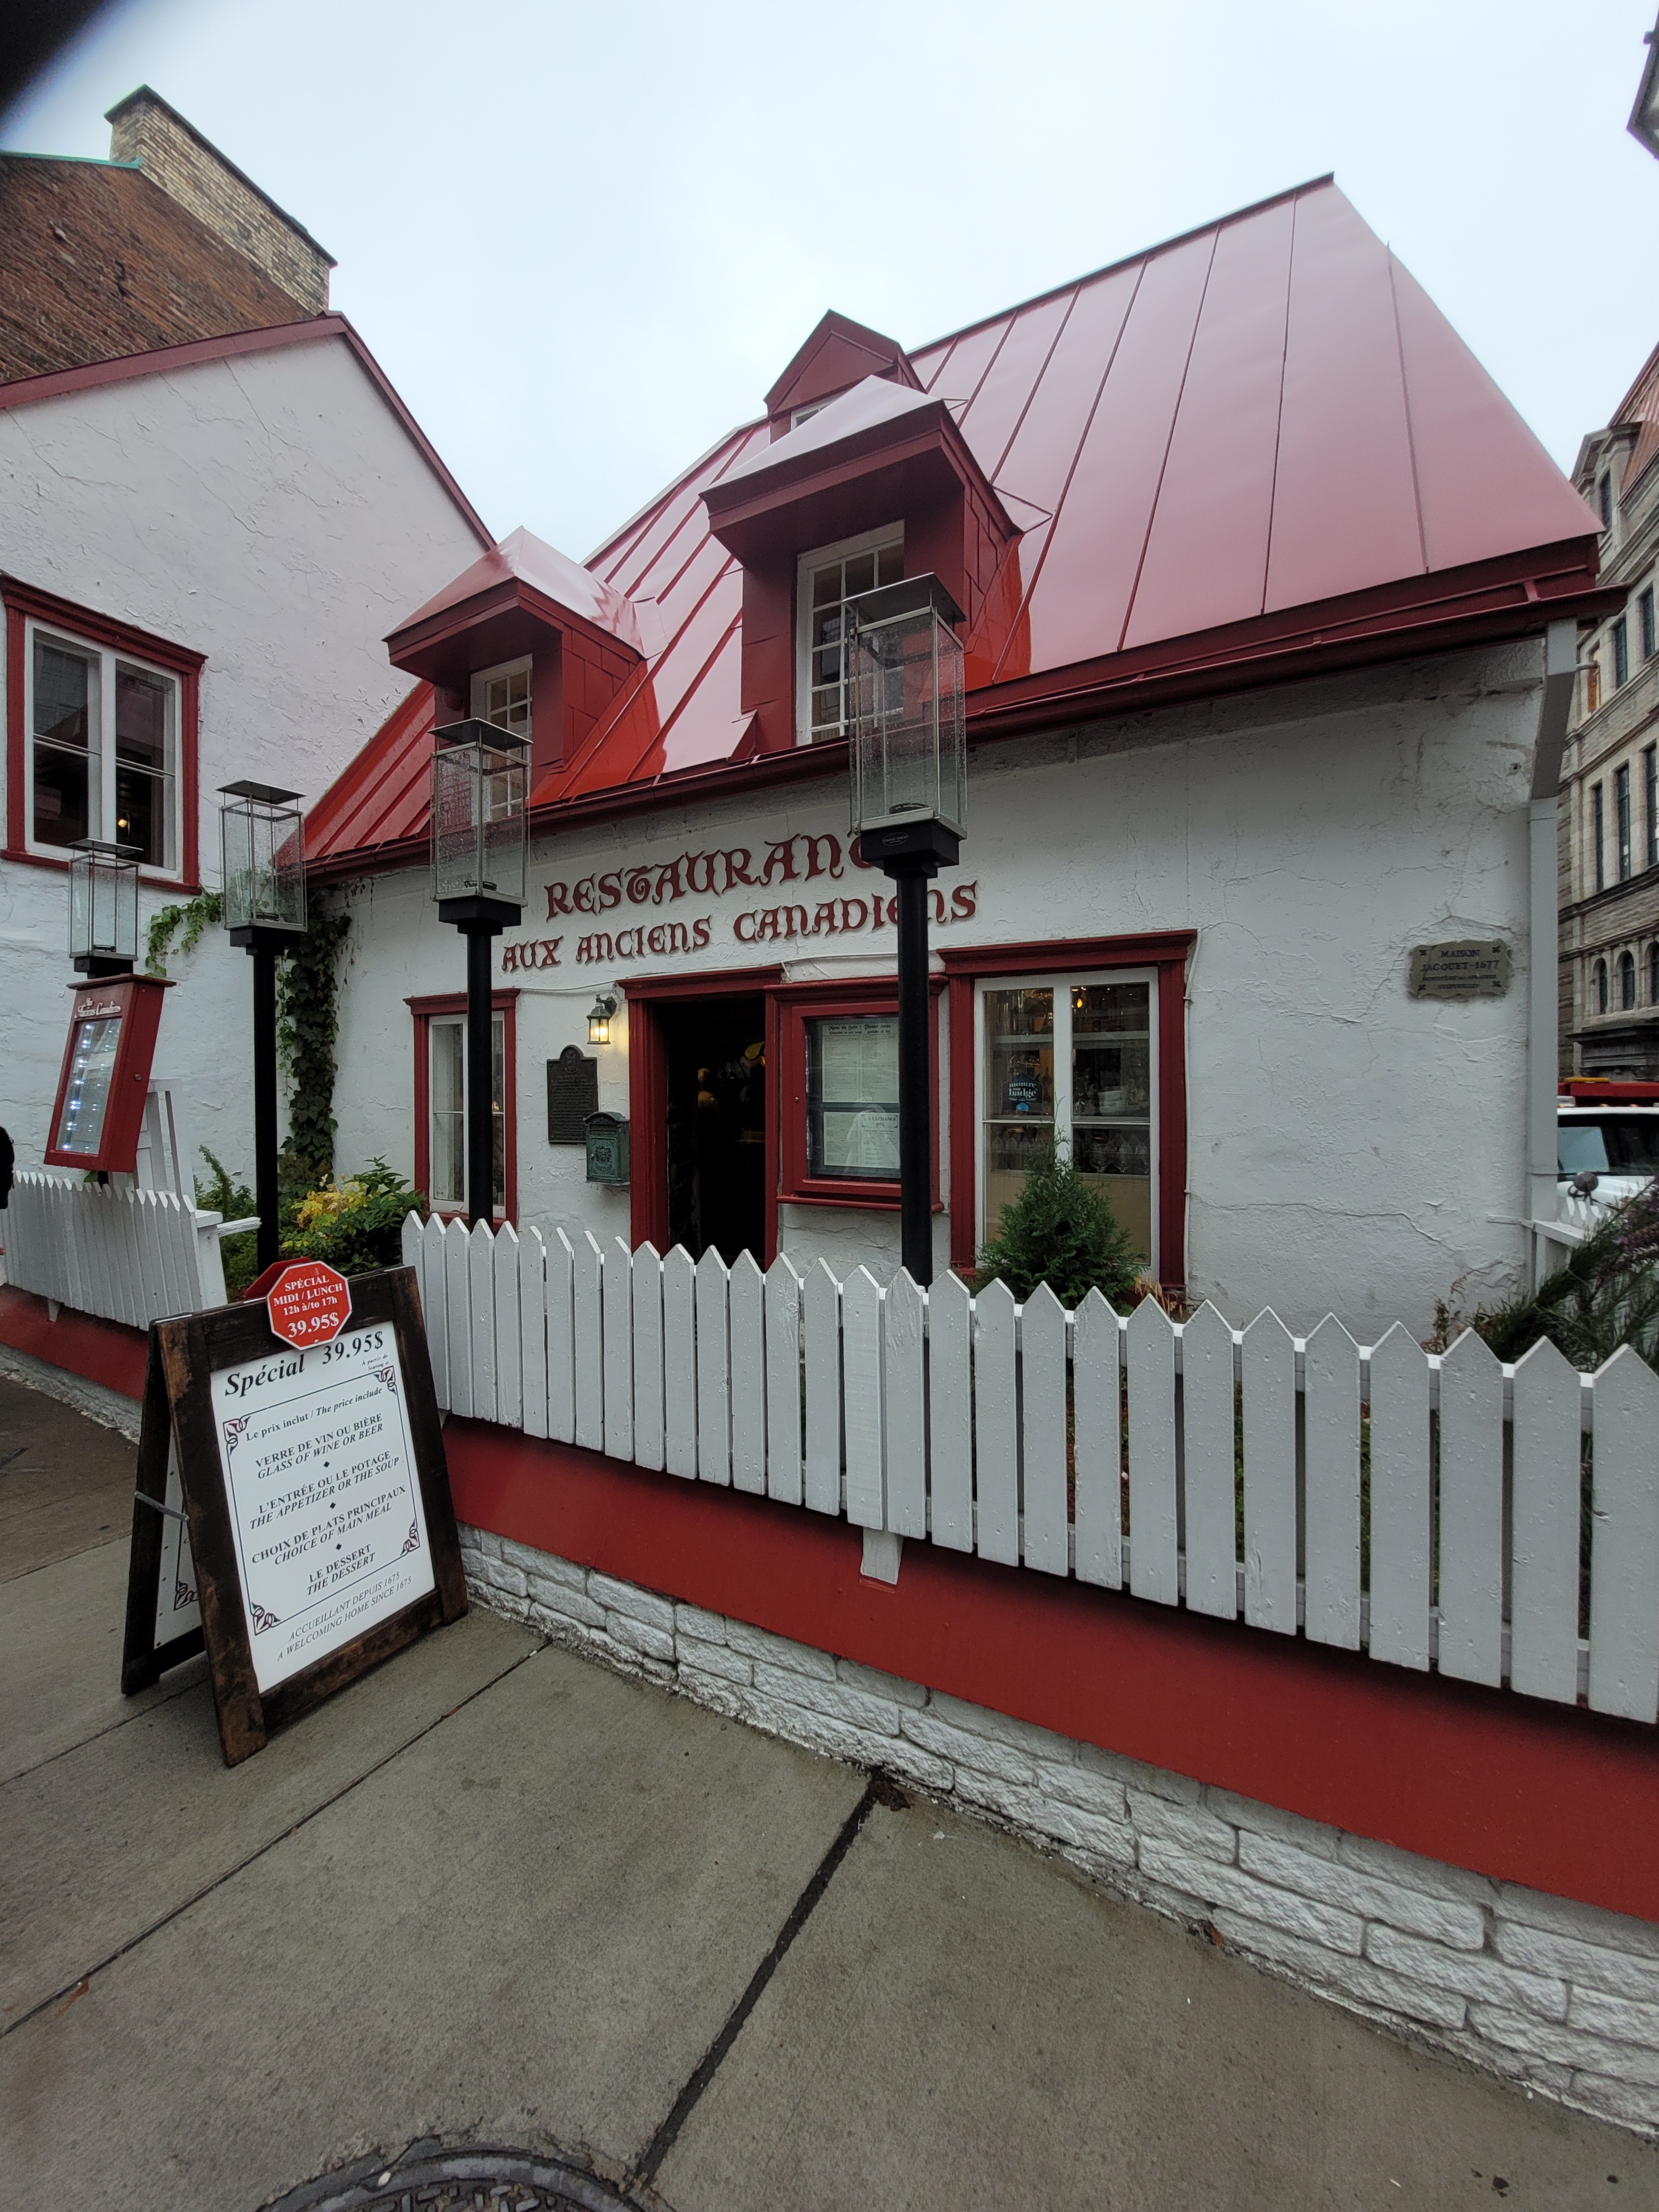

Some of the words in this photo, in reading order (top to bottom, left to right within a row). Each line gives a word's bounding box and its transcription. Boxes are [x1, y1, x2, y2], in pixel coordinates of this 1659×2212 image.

[502, 936, 564, 973] AUX
[576, 914, 712, 966] ANCIENS
[1441, 950, 1480, 958] MAISON
[1009, 1088, 1036, 1098] badge
[273, 1293, 300, 1306] MIDI
[301, 1291, 305, 1300] /
[306, 1283, 343, 1301] LUNCH
[284, 1305, 300, 1316] 12h
[322, 1296, 338, 1306] 17h
[285, 1275, 330, 1291] SPÉCIAL
[288, 1312, 339, 1338] 39.95$
[225, 1354, 305, 1397] Spécial
[322, 1331, 383, 1364] 39.95$
[367, 1356, 382, 1365] partir
[368, 1363, 384, 1371] Starting
[246, 1432, 259, 1441] Le
[262, 1423, 281, 1438] prix
[283, 1413, 309, 1428] inclut
[311, 1410, 314, 1418] /
[316, 1406, 332, 1417] The
[333, 1397, 353, 1413] price
[355, 1387, 383, 1402] include
[255, 1447, 295, 1468] VERRE
[298, 1440, 314, 1453] DE
[315, 1431, 334, 1445] VIN
[336, 1425, 352, 1438] OU
[353, 1413, 383, 1431] BIÈRE
[258, 1458, 293, 1479] GLASS
[295, 1452, 310, 1464] OF
[313, 1440, 341, 1458] WINE
[342, 1433, 356, 1446] OR
[358, 1423, 383, 1440] BEER
[249, 1512, 273, 1530] THE
[275, 1485, 335, 1519] APPETIZER
[338, 1478, 352, 1491] OR
[354, 1468, 373, 1484] THE
[375, 1457, 400, 1475] SOUP
[259, 1483, 316, 1514] L'ENTRÉE
[317, 1475, 333, 1488] OU
[336, 1469, 349, 1481] LE
[351, 1451, 391, 1474] POTAGE
[252, 1538, 291, 1563] CHOIX
[294, 1531, 310, 1545] DE
[311, 1514, 345, 1536] PLATS
[347, 1484, 406, 1519] PRINCIPAUX
[274, 1537, 317, 1565] CHOICE
[320, 1530, 334, 1543] OF
[337, 1517, 363, 1536] MAIN
[365, 1502, 392, 1521] MEAL
[307, 1577, 329, 1596] THE
[331, 1552, 376, 1583] DESSERT
[309, 1569, 324, 1583] LE
[326, 1543, 372, 1575] DESSERT
[277, 1651, 284, 1661] A
[286, 1616, 342, 1655] WELCOMING
[344, 1601, 370, 1623] HOME
[371, 1586, 395, 1606] SINCE
[396, 1576, 412, 1592] 1675
[289, 1599, 351, 1642] ACCUEILLANT
[352, 1582, 383, 1605] DEPUIS
[384, 1572, 400, 1587] 1675
